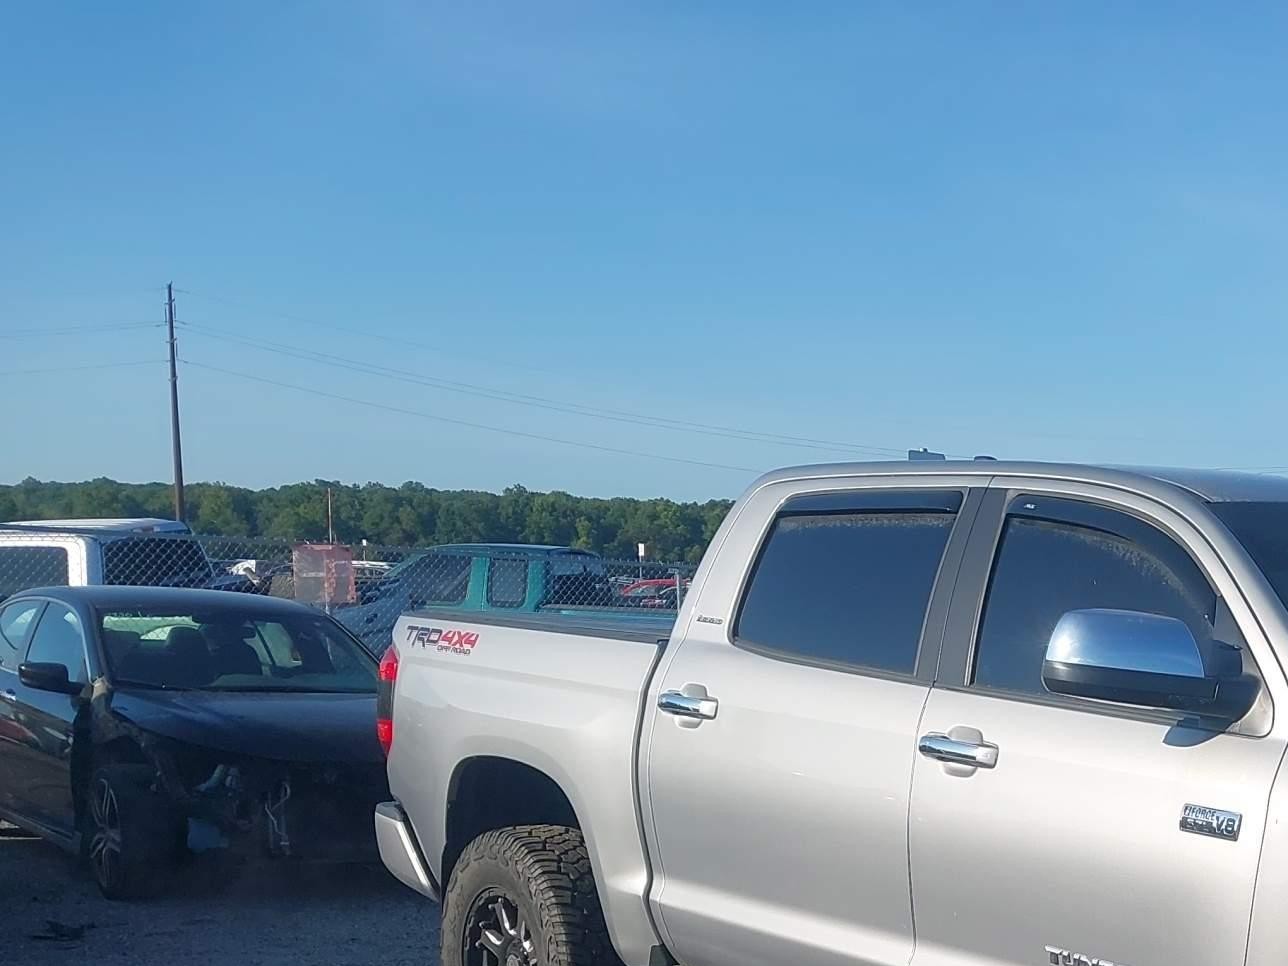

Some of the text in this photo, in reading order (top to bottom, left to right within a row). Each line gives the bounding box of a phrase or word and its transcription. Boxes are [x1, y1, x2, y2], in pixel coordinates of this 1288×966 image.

[407, 625, 443, 648] TRD
[437, 644, 471, 655] OFF ROAD
[1215, 815, 1236, 834] V8
